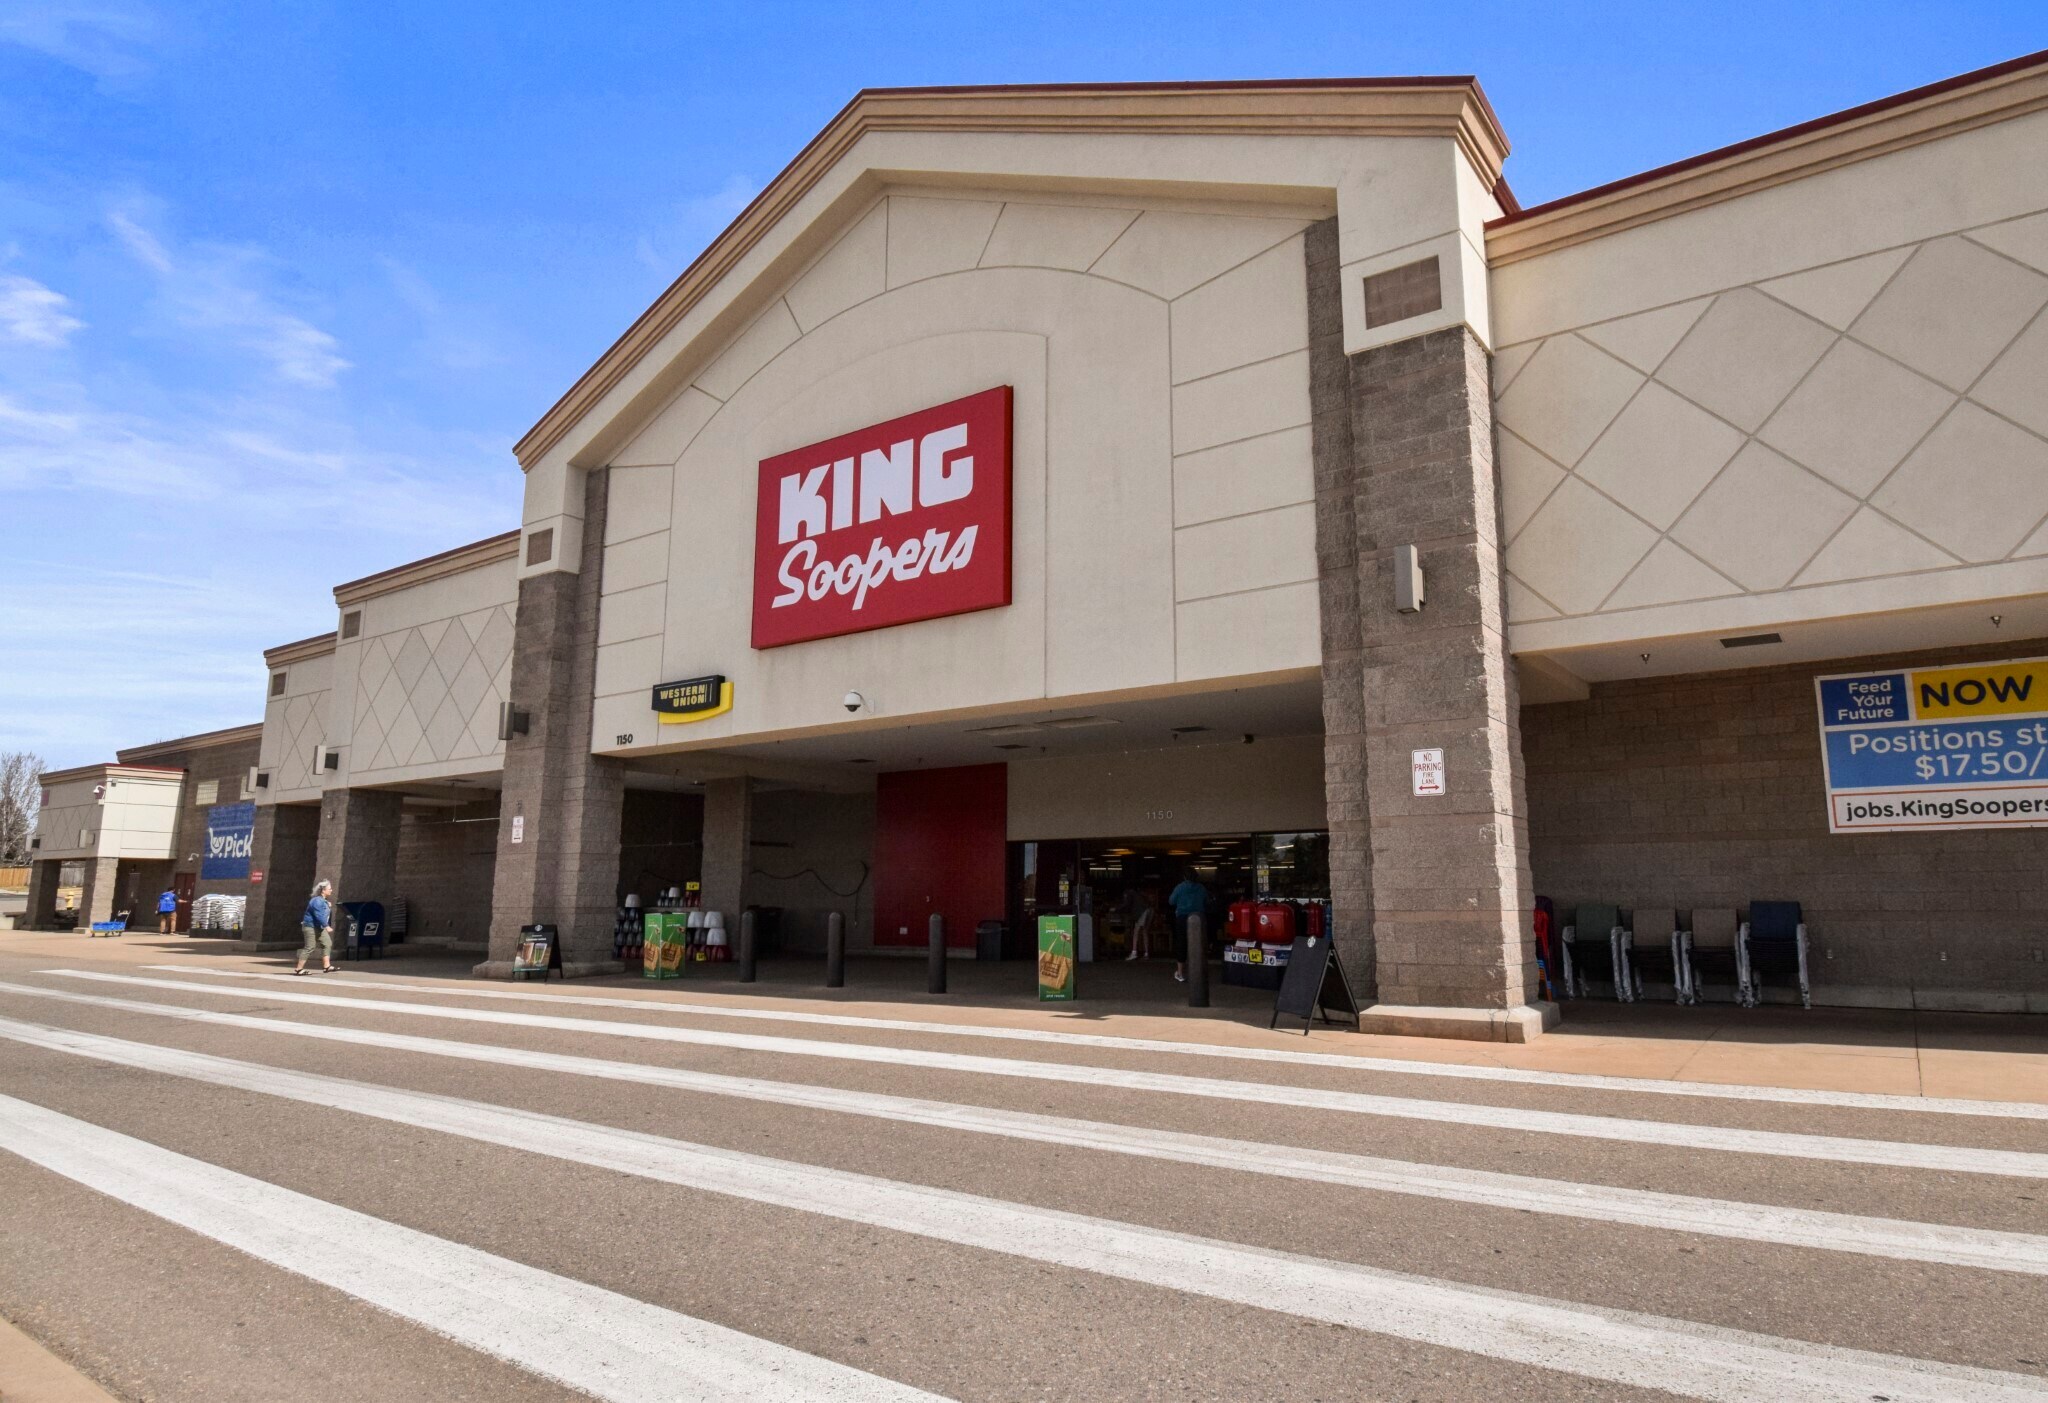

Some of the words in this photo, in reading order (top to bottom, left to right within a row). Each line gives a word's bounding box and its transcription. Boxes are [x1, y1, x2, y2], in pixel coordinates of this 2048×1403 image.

[778, 422, 974, 545] KING
[771, 524, 979, 611] Soopers
[660, 684, 705, 700] WESTERN
[1848, 679, 1892, 694] Feed
[1920, 675, 2033, 708] NOW
[673, 694, 705, 708] UNION
[1852, 695, 1893, 707] Your
[1838, 708, 1895, 721] Future
[616, 733, 634, 746] 1150
[1849, 728, 2004, 755] Positions
[1423, 752, 1433, 762] NO
[1915, 746, 2046, 780] $17.50/
[1414, 762, 1442, 772] PARKING
[1145, 810, 1173, 820] 1150
